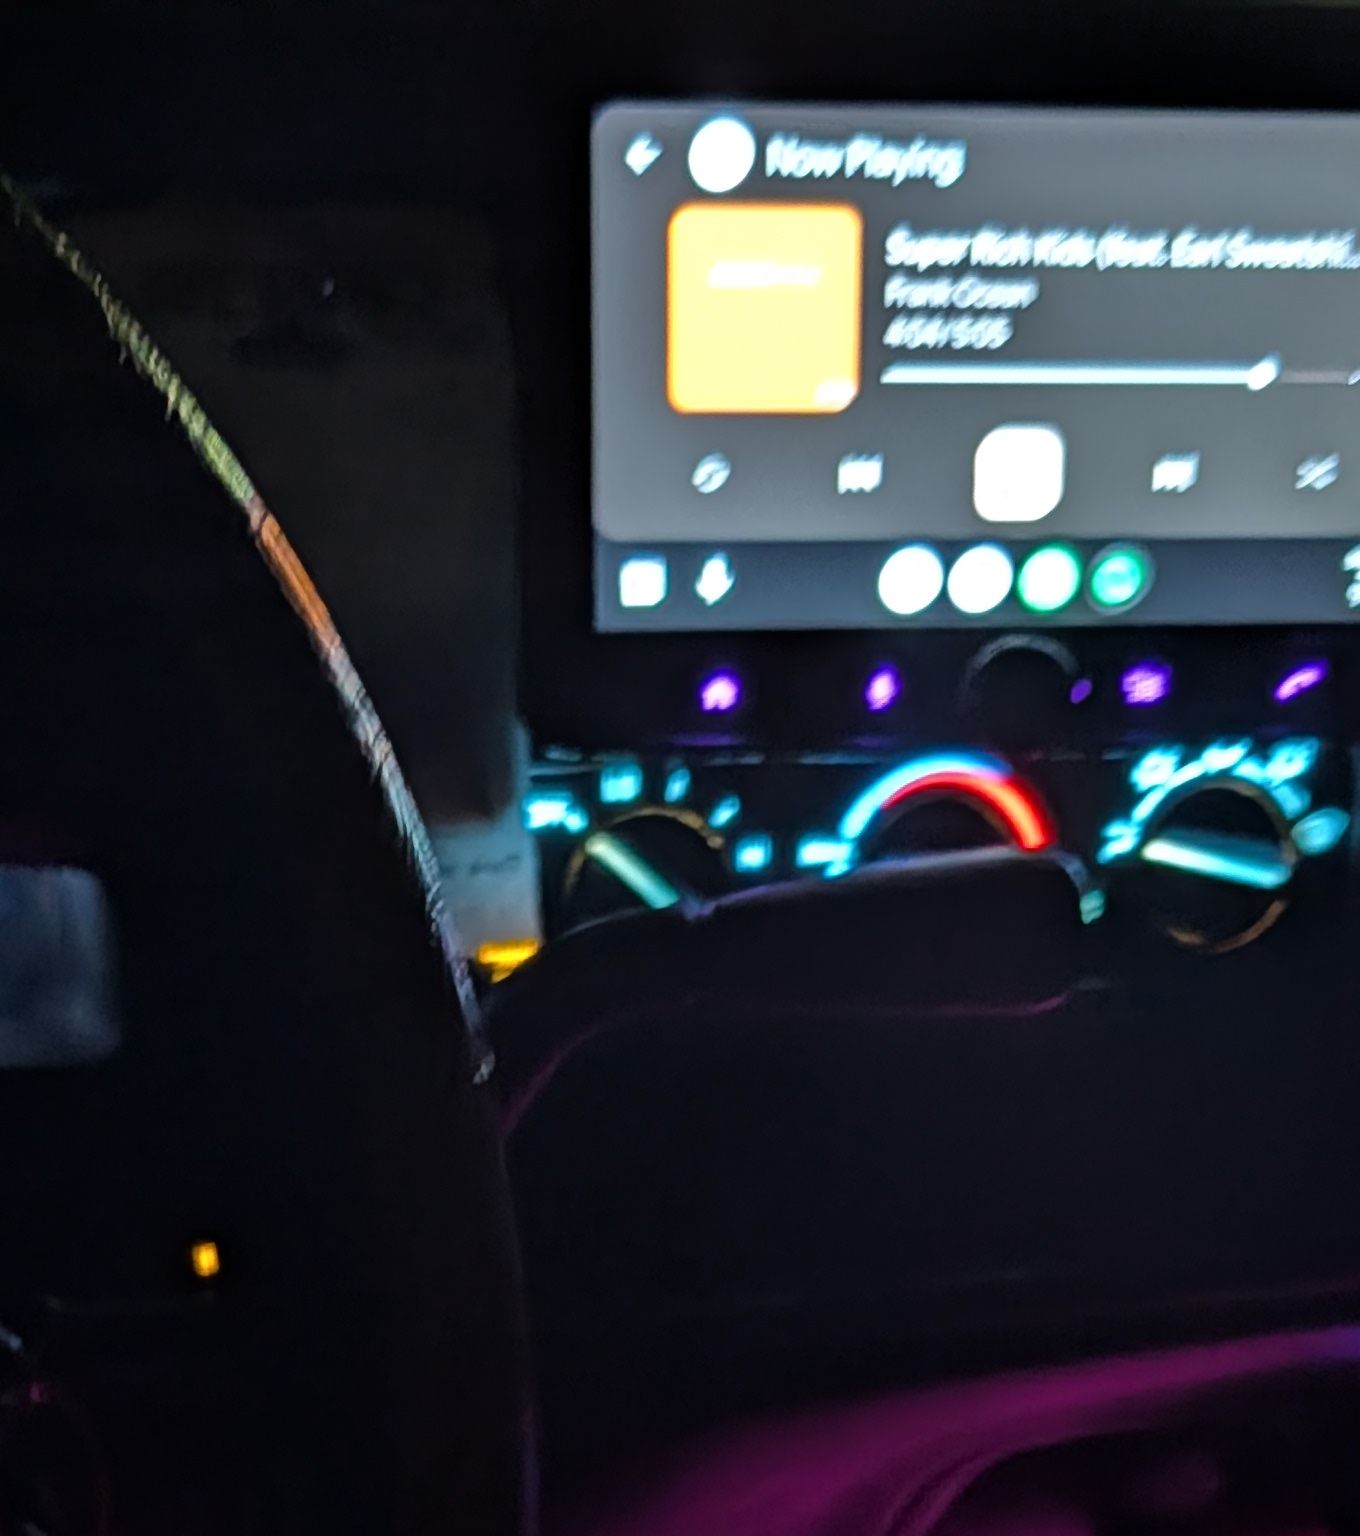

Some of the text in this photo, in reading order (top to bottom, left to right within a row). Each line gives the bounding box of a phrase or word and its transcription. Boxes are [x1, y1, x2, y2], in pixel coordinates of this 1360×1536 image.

[766, 133, 967, 188] Now Playing
[885, 226, 971, 272] Super
[971, 228, 1033, 268] Rich
[1033, 229, 1095, 268] Kids
